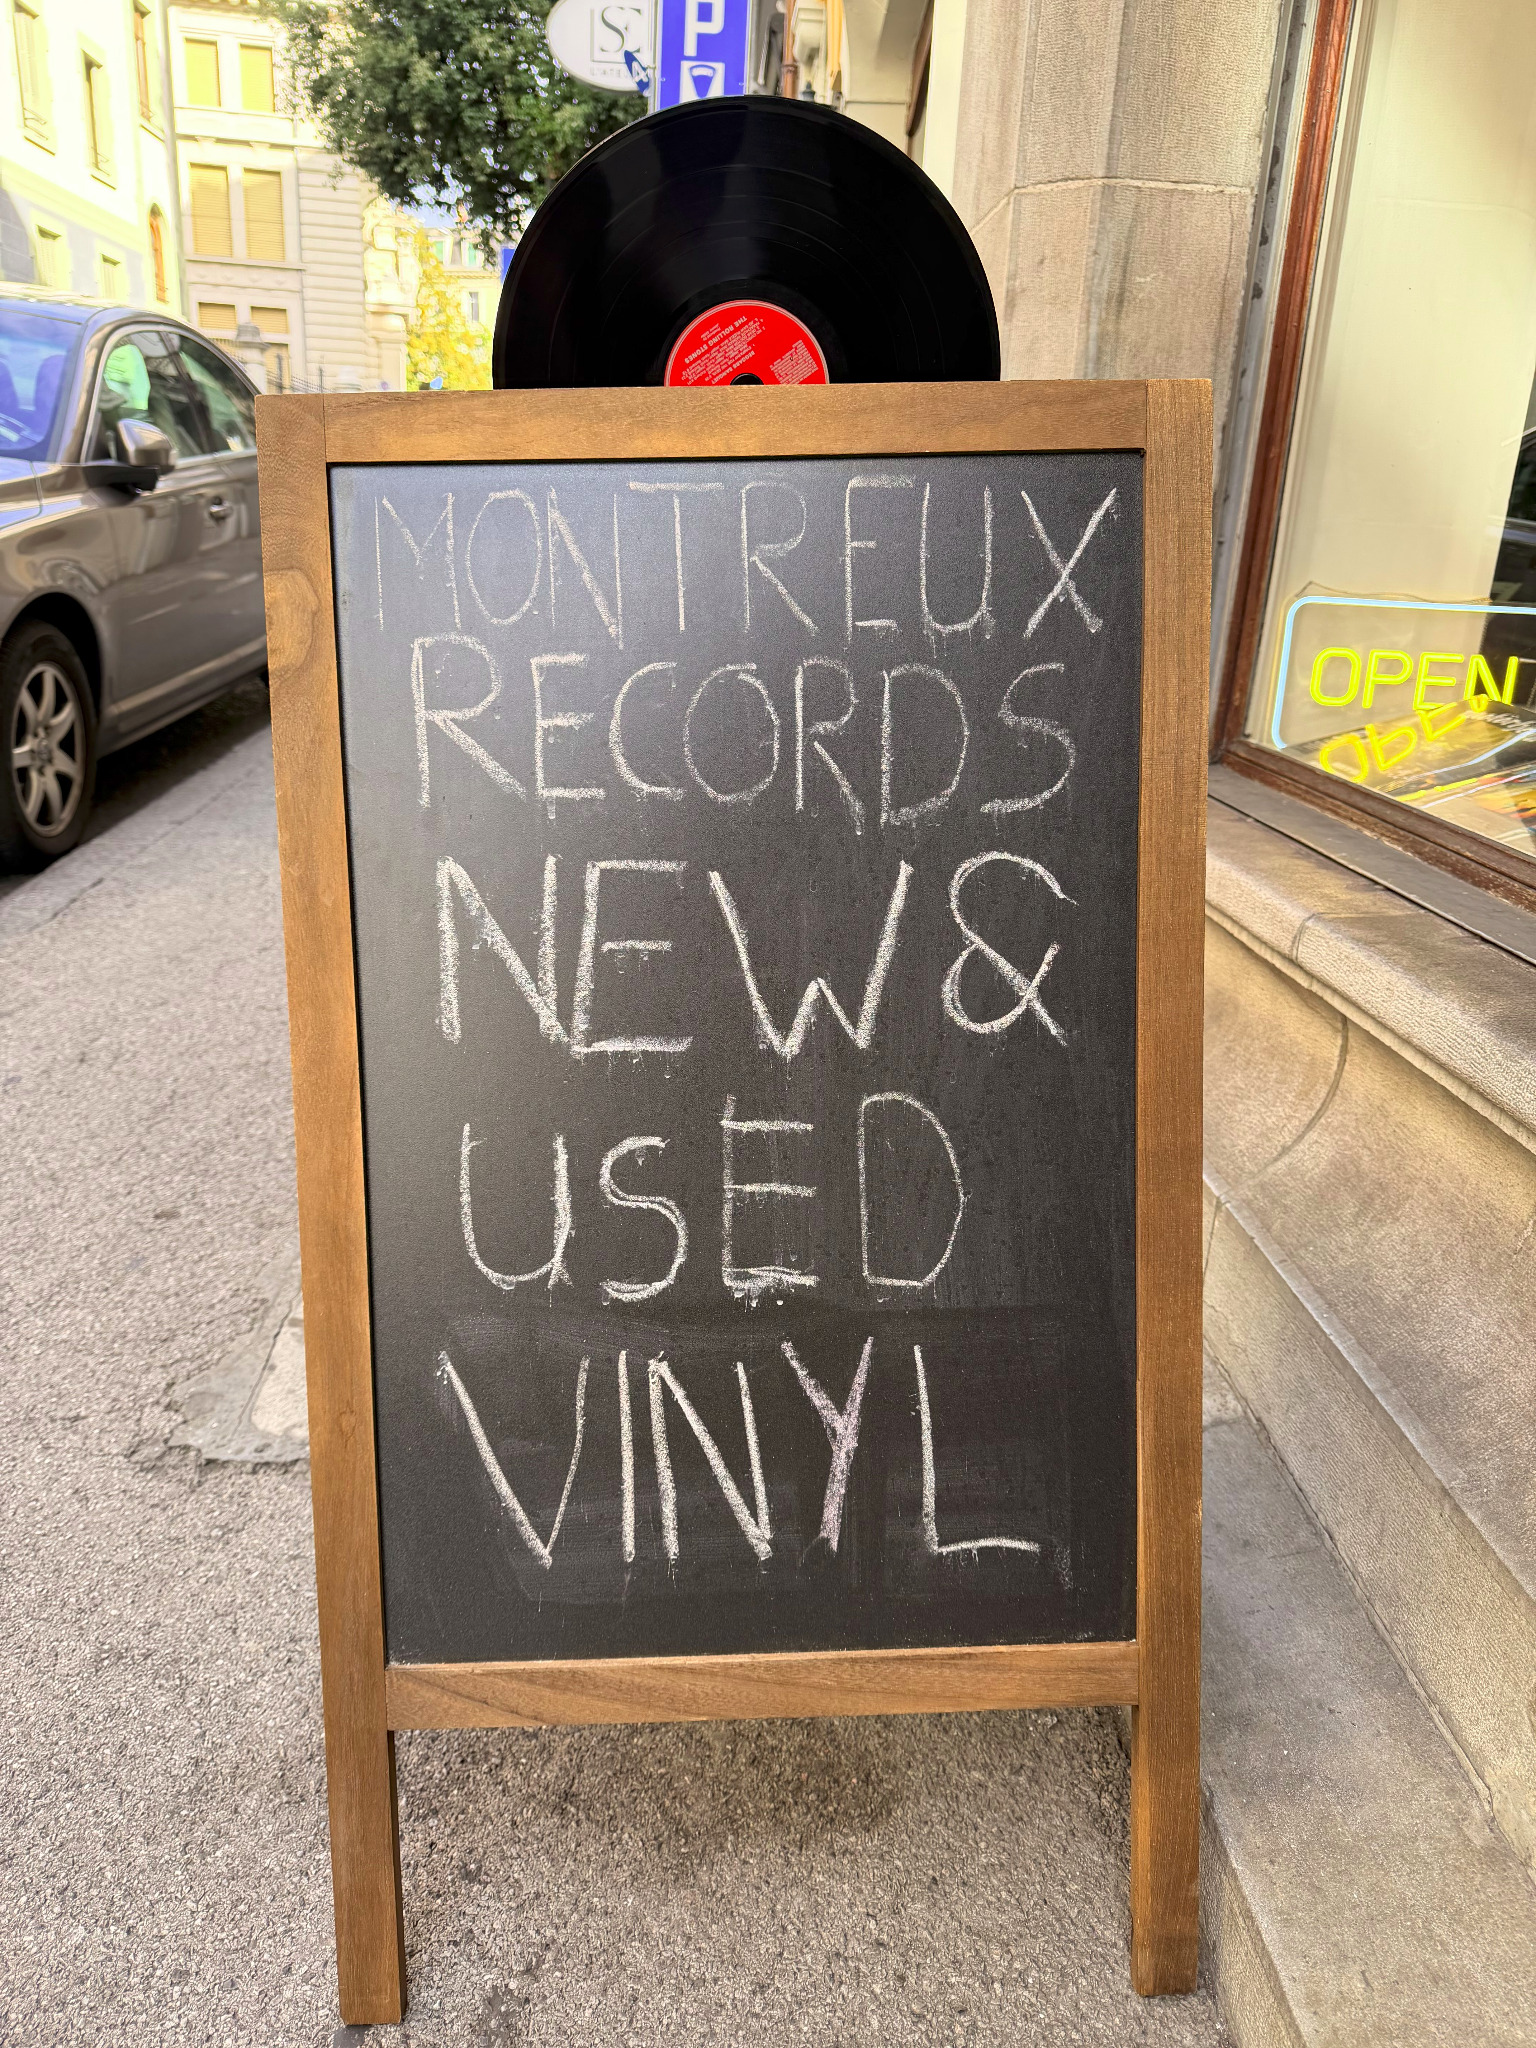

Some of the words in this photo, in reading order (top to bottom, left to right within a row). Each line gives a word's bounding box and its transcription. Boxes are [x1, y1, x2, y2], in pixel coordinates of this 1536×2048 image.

[684, 0, 725, 57] P
[708, 325, 734, 346] ROLLING
[734, 315, 747, 327] THE
[685, 346, 707, 364] STONES
[732, 351, 755, 368] BEGGARS
[375, 474, 1119, 641] MONTREUX
[1310, 647, 1519, 711] OPEN
[410, 632, 1078, 834] RECORDS
[435, 853, 916, 1060] NEW
[942, 850, 1079, 1049] &
[459, 1091, 972, 1304] USED
[435, 1336, 1041, 1570] VINYL
